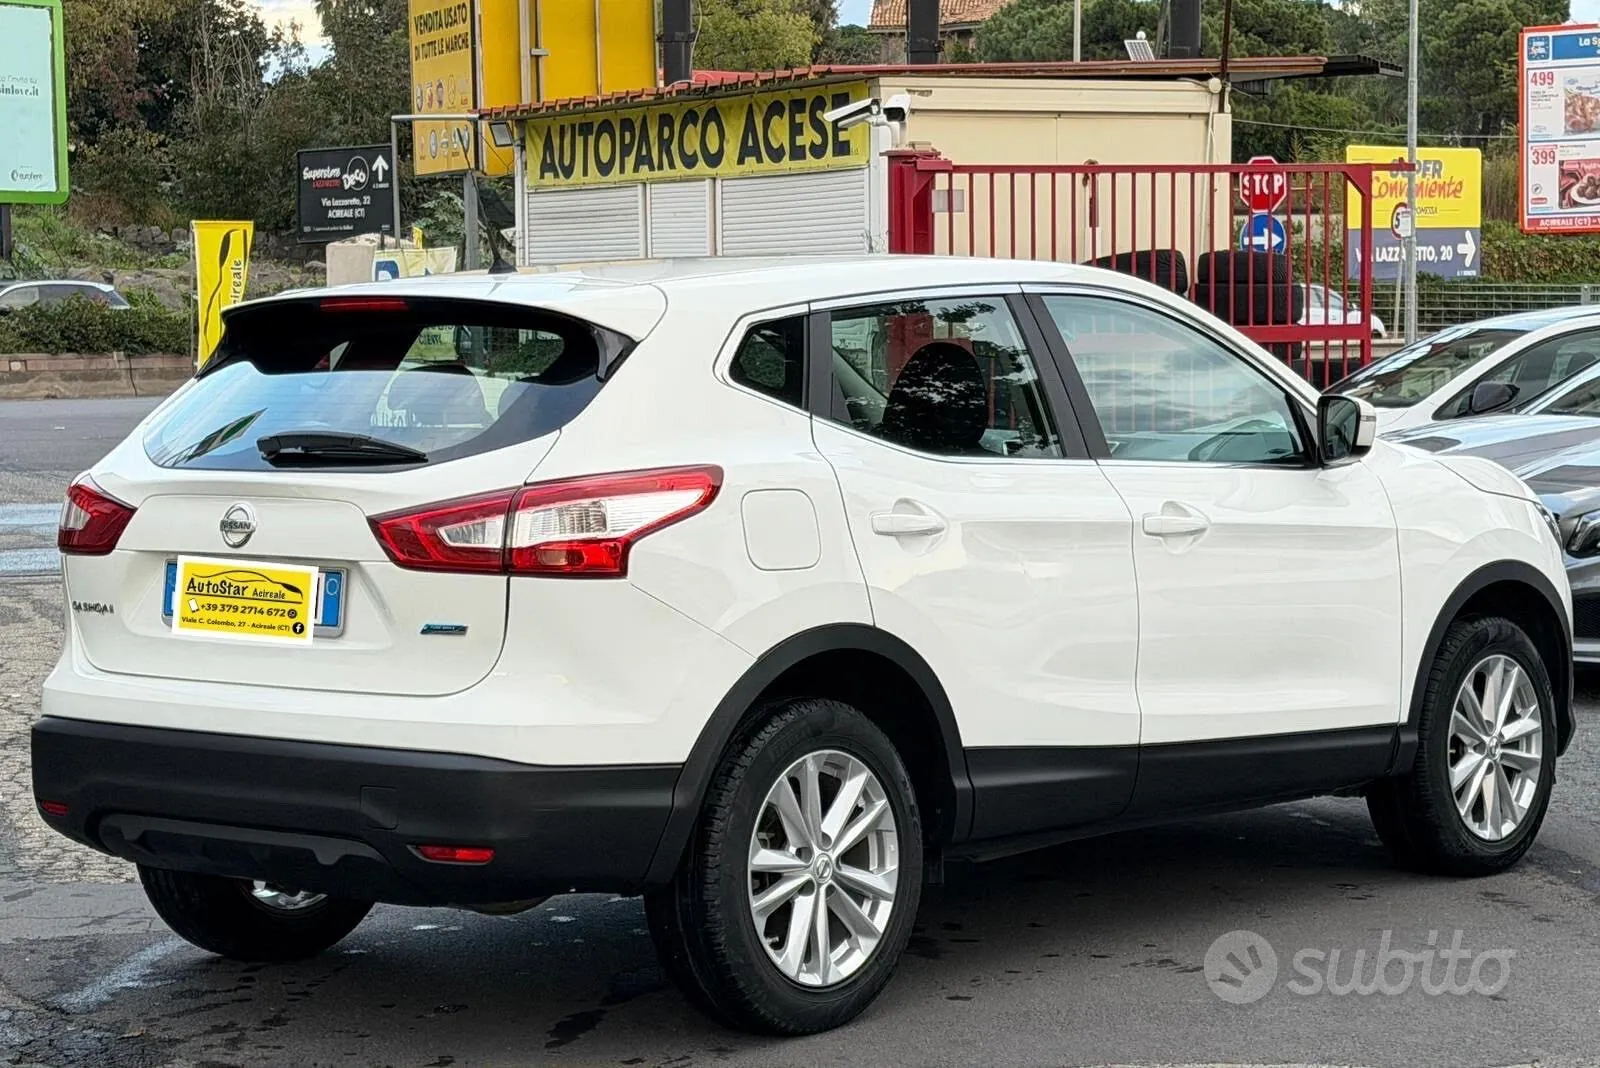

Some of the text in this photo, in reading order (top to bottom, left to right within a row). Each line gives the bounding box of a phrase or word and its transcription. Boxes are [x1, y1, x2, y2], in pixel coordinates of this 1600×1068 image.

[413, 2, 468, 36] VENDITA USATO
[414, 32, 469, 61] DI TUTTE LE MARCHE
[1579, 37, 1590, 47] La
[1530, 71, 1554, 87] 499
[539, 92, 850, 180] AUTOPARCO ACESE
[1532, 150, 1556, 165] 399
[302, 166, 341, 181] Superstore
[321, 198, 332, 207] Via
[1574, 216, 1591, 226] (CT)
[1440, 245, 1453, 261] 20
[221, 520, 252, 531] NISSAN
[186, 577, 286, 600] AutoStar Acireale
[200, 602, 286, 618] +39 379 2714 672
[181, 616, 197, 624] Viale
[206, 618, 236, 628] Colombo,
[251, 622, 276, 631] Acireale
[277, 623, 290, 632] (CT)
